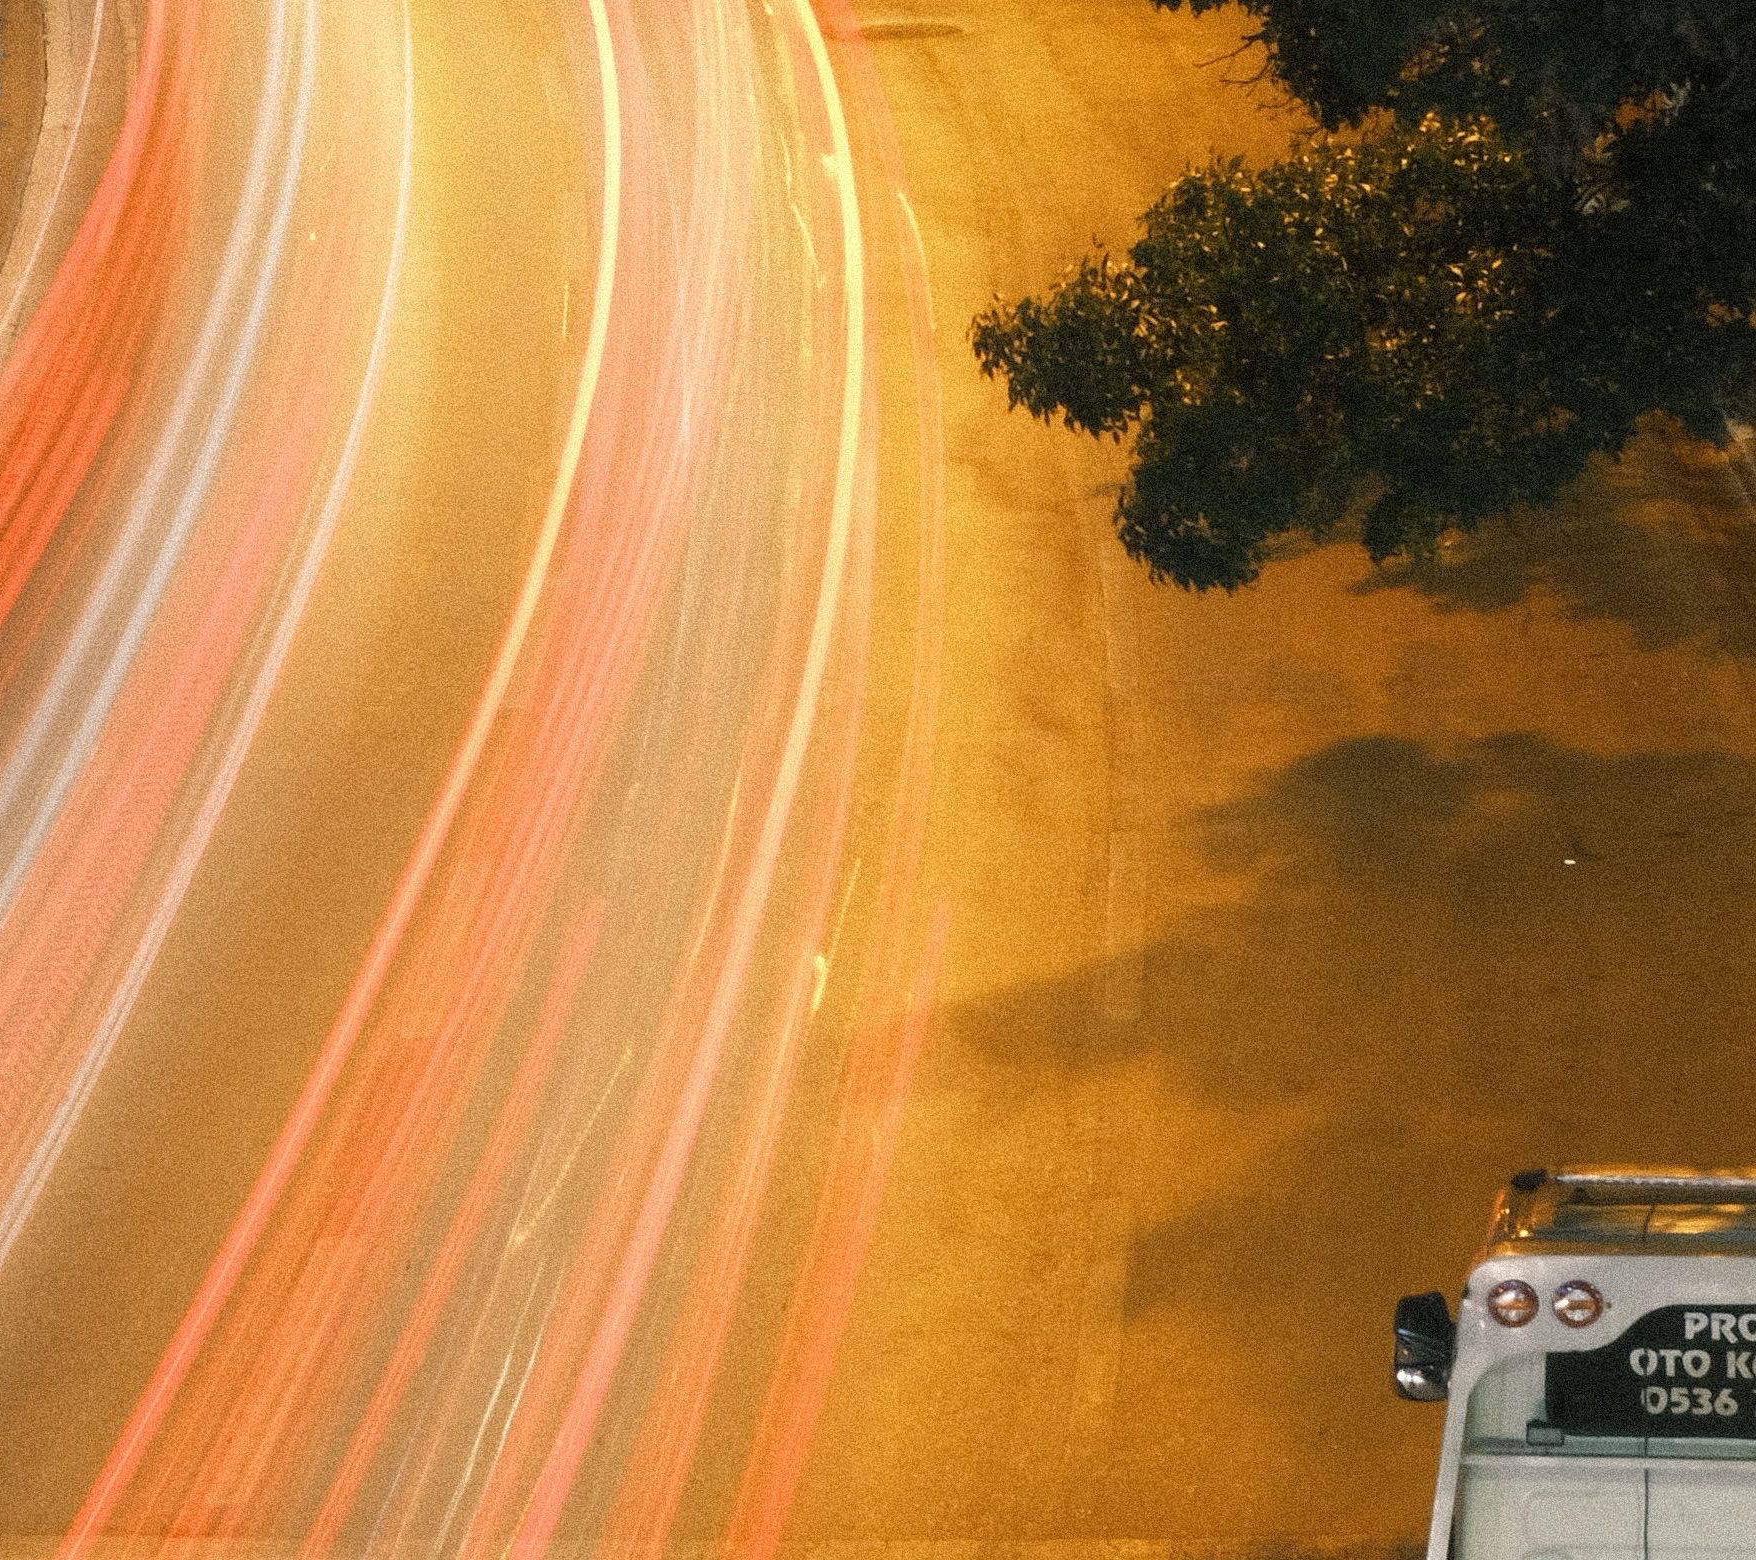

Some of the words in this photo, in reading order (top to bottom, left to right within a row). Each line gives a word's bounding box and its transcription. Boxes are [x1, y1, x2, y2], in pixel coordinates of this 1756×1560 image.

[1629, 1347, 1711, 1378] OTO
[1726, 1350, 1756, 1379] K
[1640, 1385, 1738, 1417] 0536
